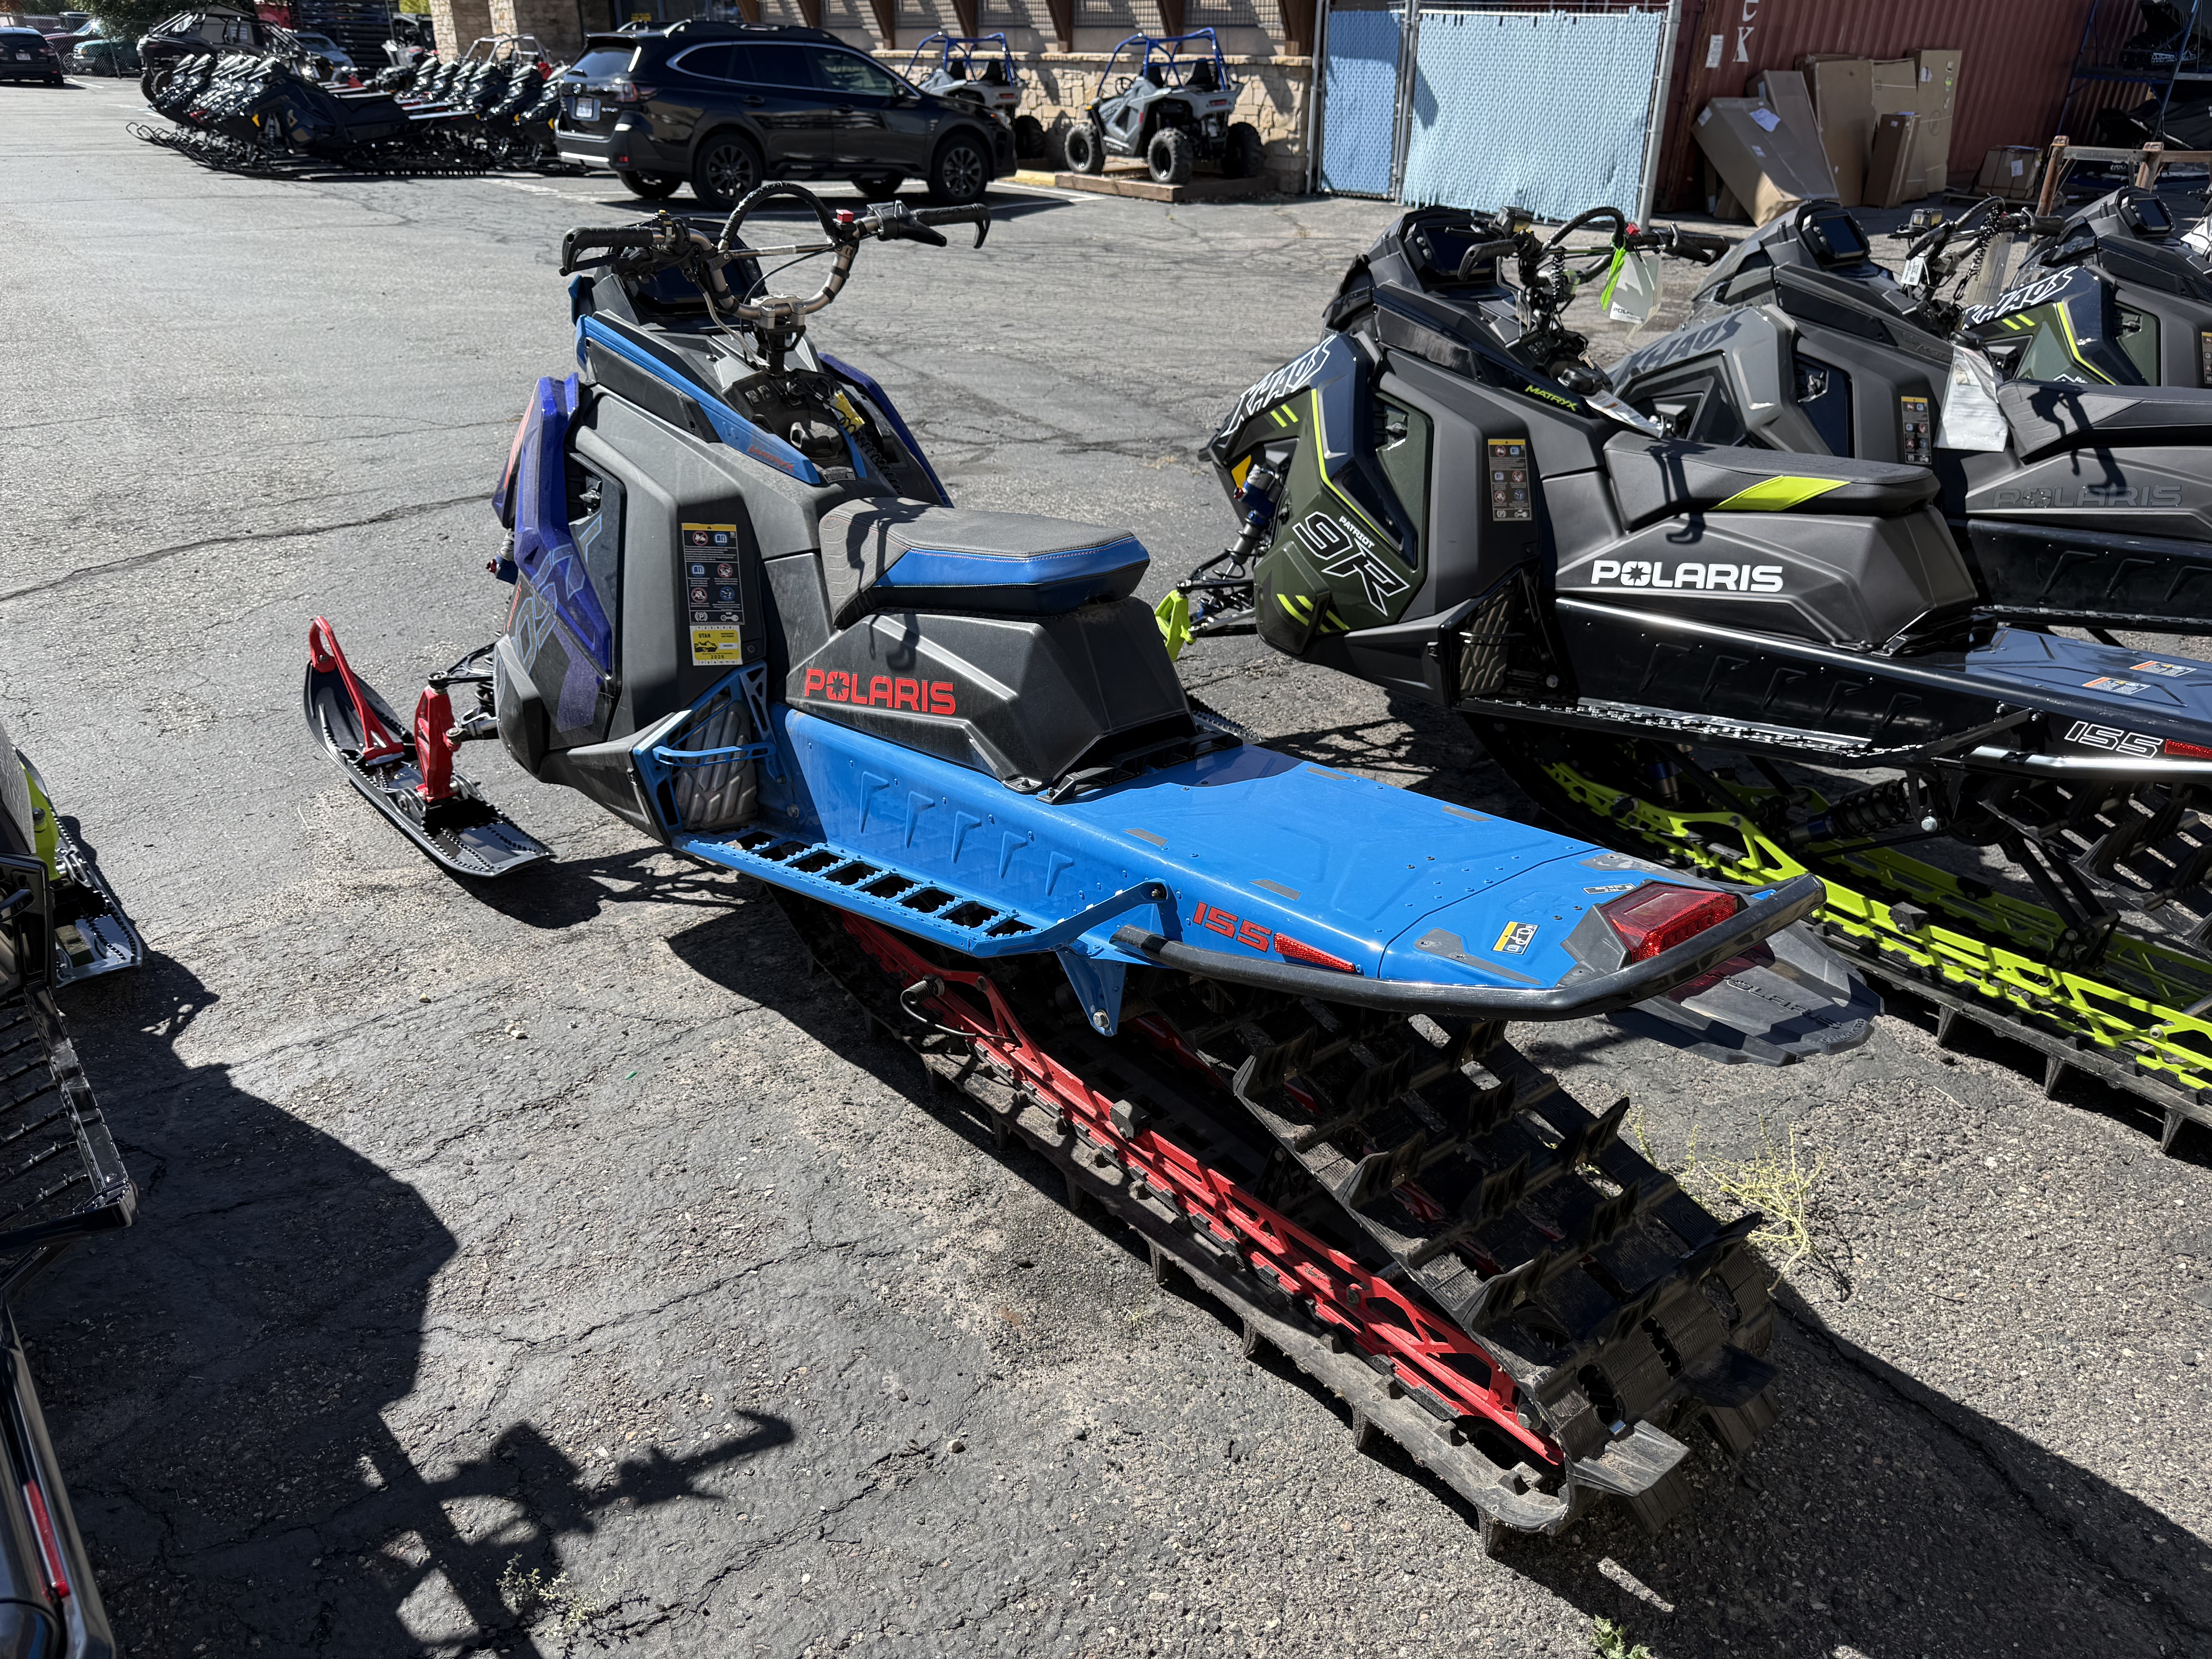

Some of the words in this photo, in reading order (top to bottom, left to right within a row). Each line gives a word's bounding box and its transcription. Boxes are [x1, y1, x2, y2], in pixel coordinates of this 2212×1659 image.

[1615, 308, 1750, 386] KHAOS
[1220, 334, 1337, 438] KHAOS
[1525, 385, 1578, 412] MATRYX
[747, 445, 794, 473] MATRYX
[1992, 485, 2182, 508] POLARIS
[1339, 515, 1375, 548] PATRIOT
[1292, 511, 1410, 617] 9R
[1591, 560, 1784, 592] POLARIS
[804, 667, 956, 715] POLARIS
[2064, 720, 2164, 759] 155
[1192, 901, 1273, 953] 155
